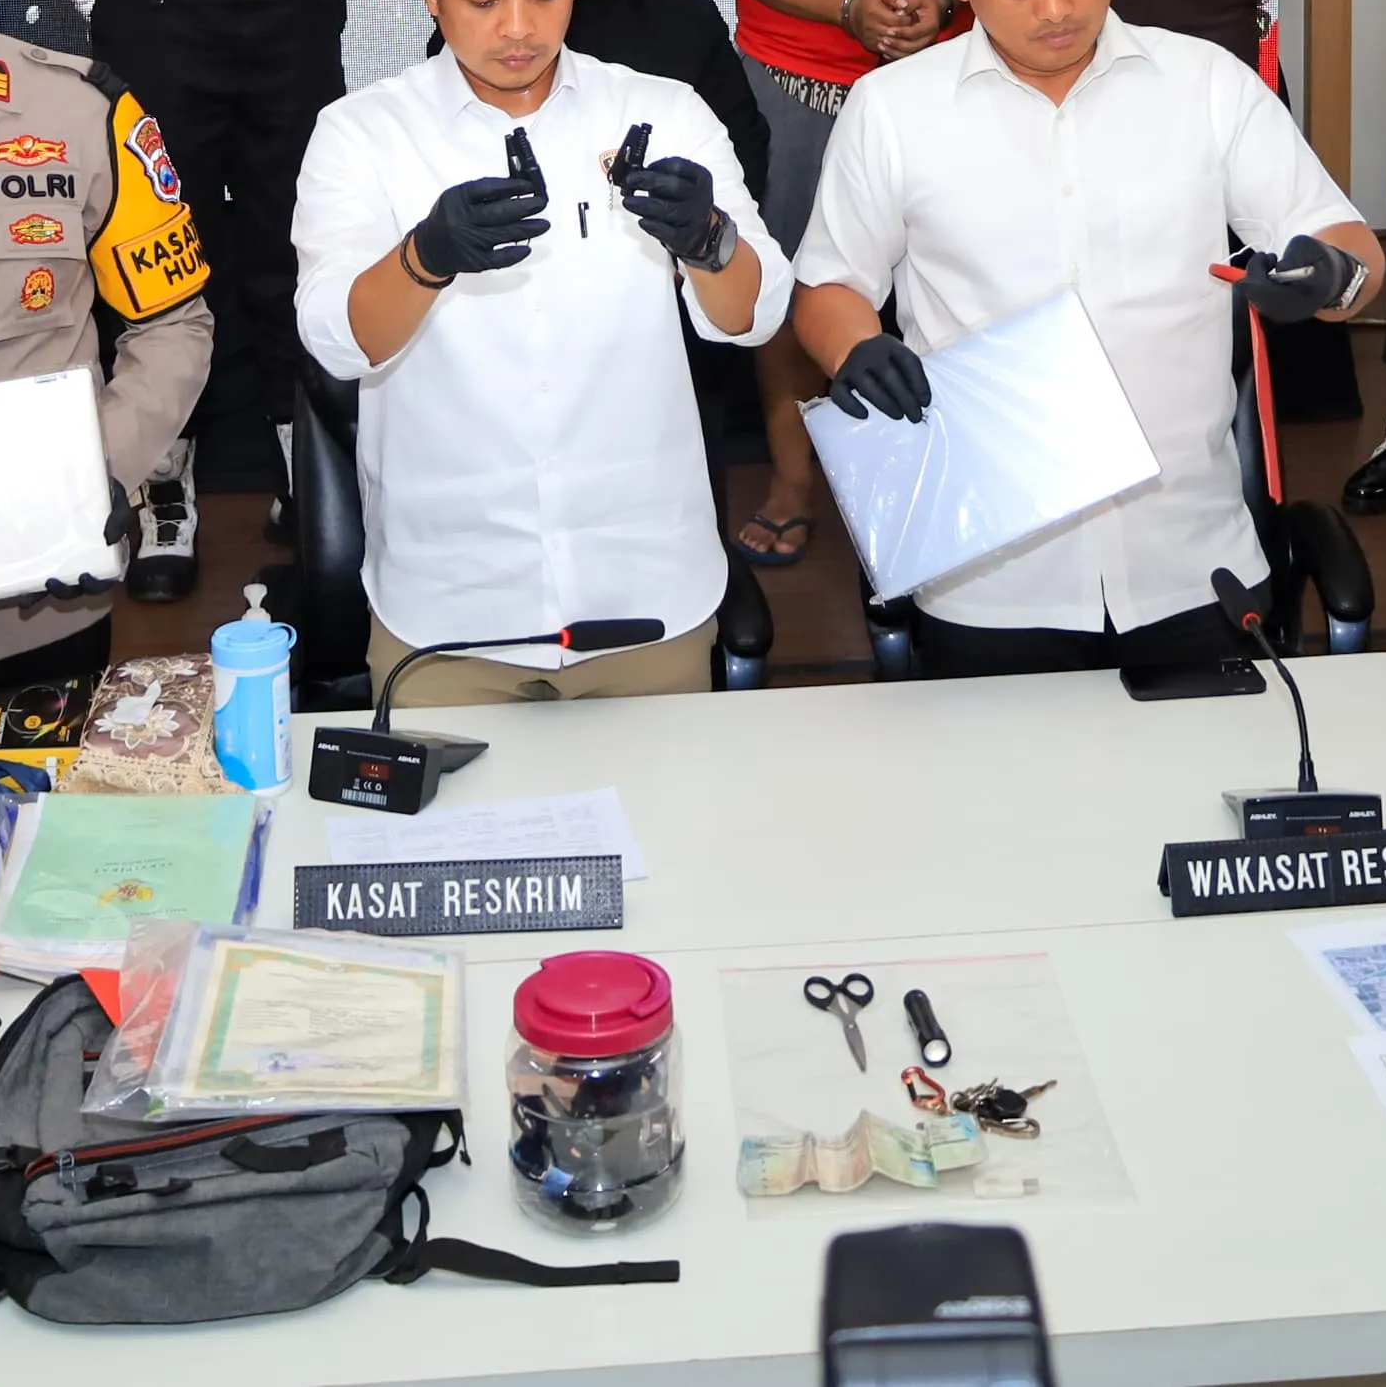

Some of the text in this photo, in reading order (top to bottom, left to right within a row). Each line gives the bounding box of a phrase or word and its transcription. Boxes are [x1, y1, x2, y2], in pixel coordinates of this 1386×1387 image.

[1188, 851, 1329, 897] WAKASAT
[327, 875, 583, 920] KASAT RESKRIM
